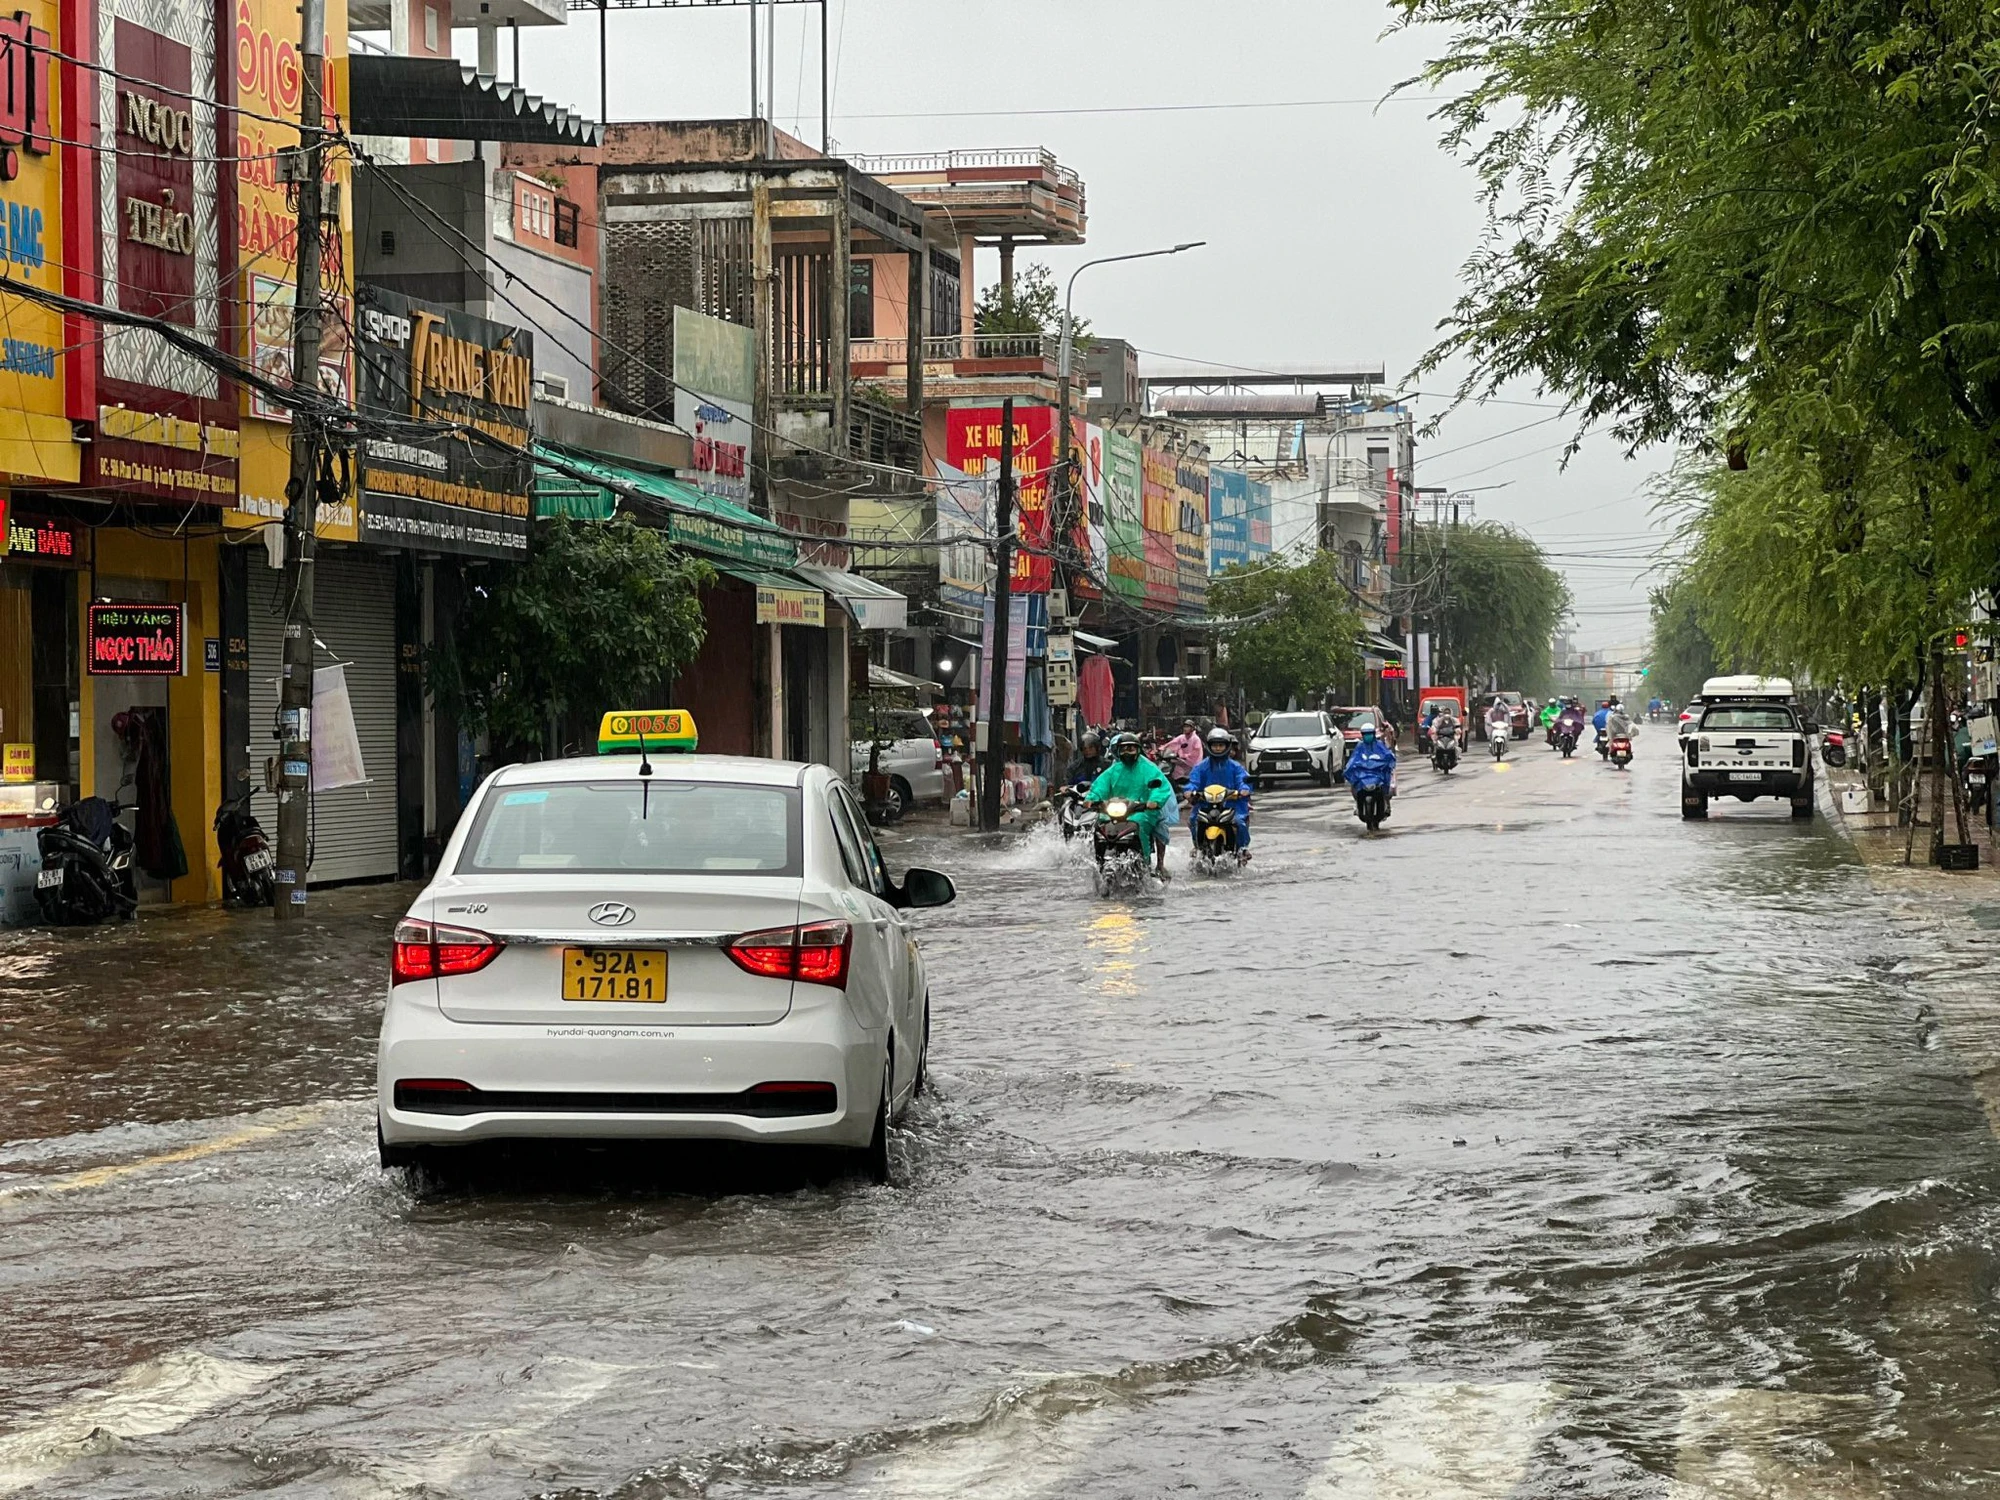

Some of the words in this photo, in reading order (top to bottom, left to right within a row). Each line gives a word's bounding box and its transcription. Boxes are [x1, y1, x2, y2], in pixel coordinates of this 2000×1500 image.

[126, 188, 194, 256] THẢO
[9, 201, 44, 279] BẠC
[363, 310, 411, 349] SHOP
[966, 425, 982, 448] XE
[987, 424, 1029, 447] HODA
[98, 612, 128, 626] HIỆU
[132, 611, 172, 625] VÀNG
[95, 637, 134, 666] NGỌC
[136, 628, 174, 662] THẢO
[628, 714, 680, 734] 1055
[593, 952, 637, 974] 92A
[577, 976, 652, 999] 171.81
[547, 1028, 675, 1039] hyundai-quangnam.com.vn
